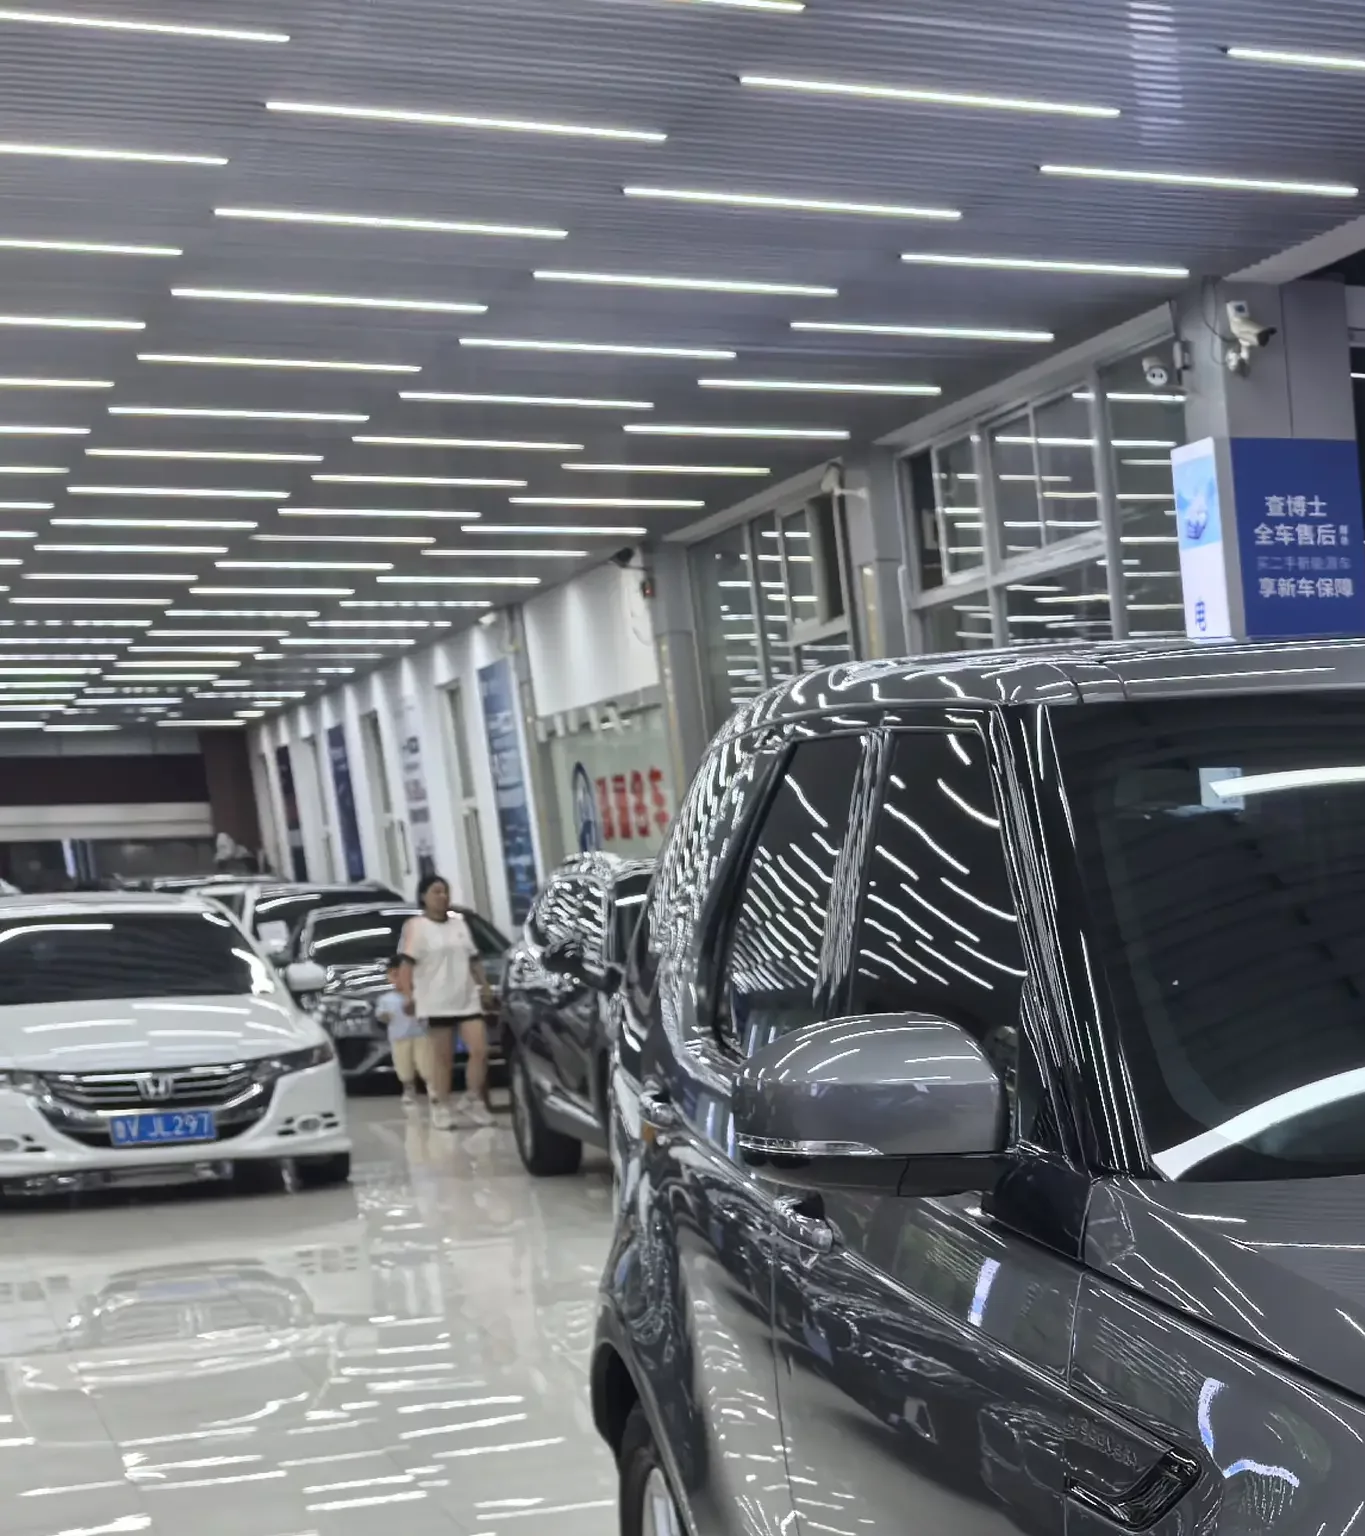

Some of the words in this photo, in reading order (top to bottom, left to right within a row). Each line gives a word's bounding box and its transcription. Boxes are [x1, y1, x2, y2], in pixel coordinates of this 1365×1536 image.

[1264, 495, 1328, 517] 查博士
[1253, 524, 1336, 546] 全车售后
[1258, 578, 1354, 598] 享新车保障
